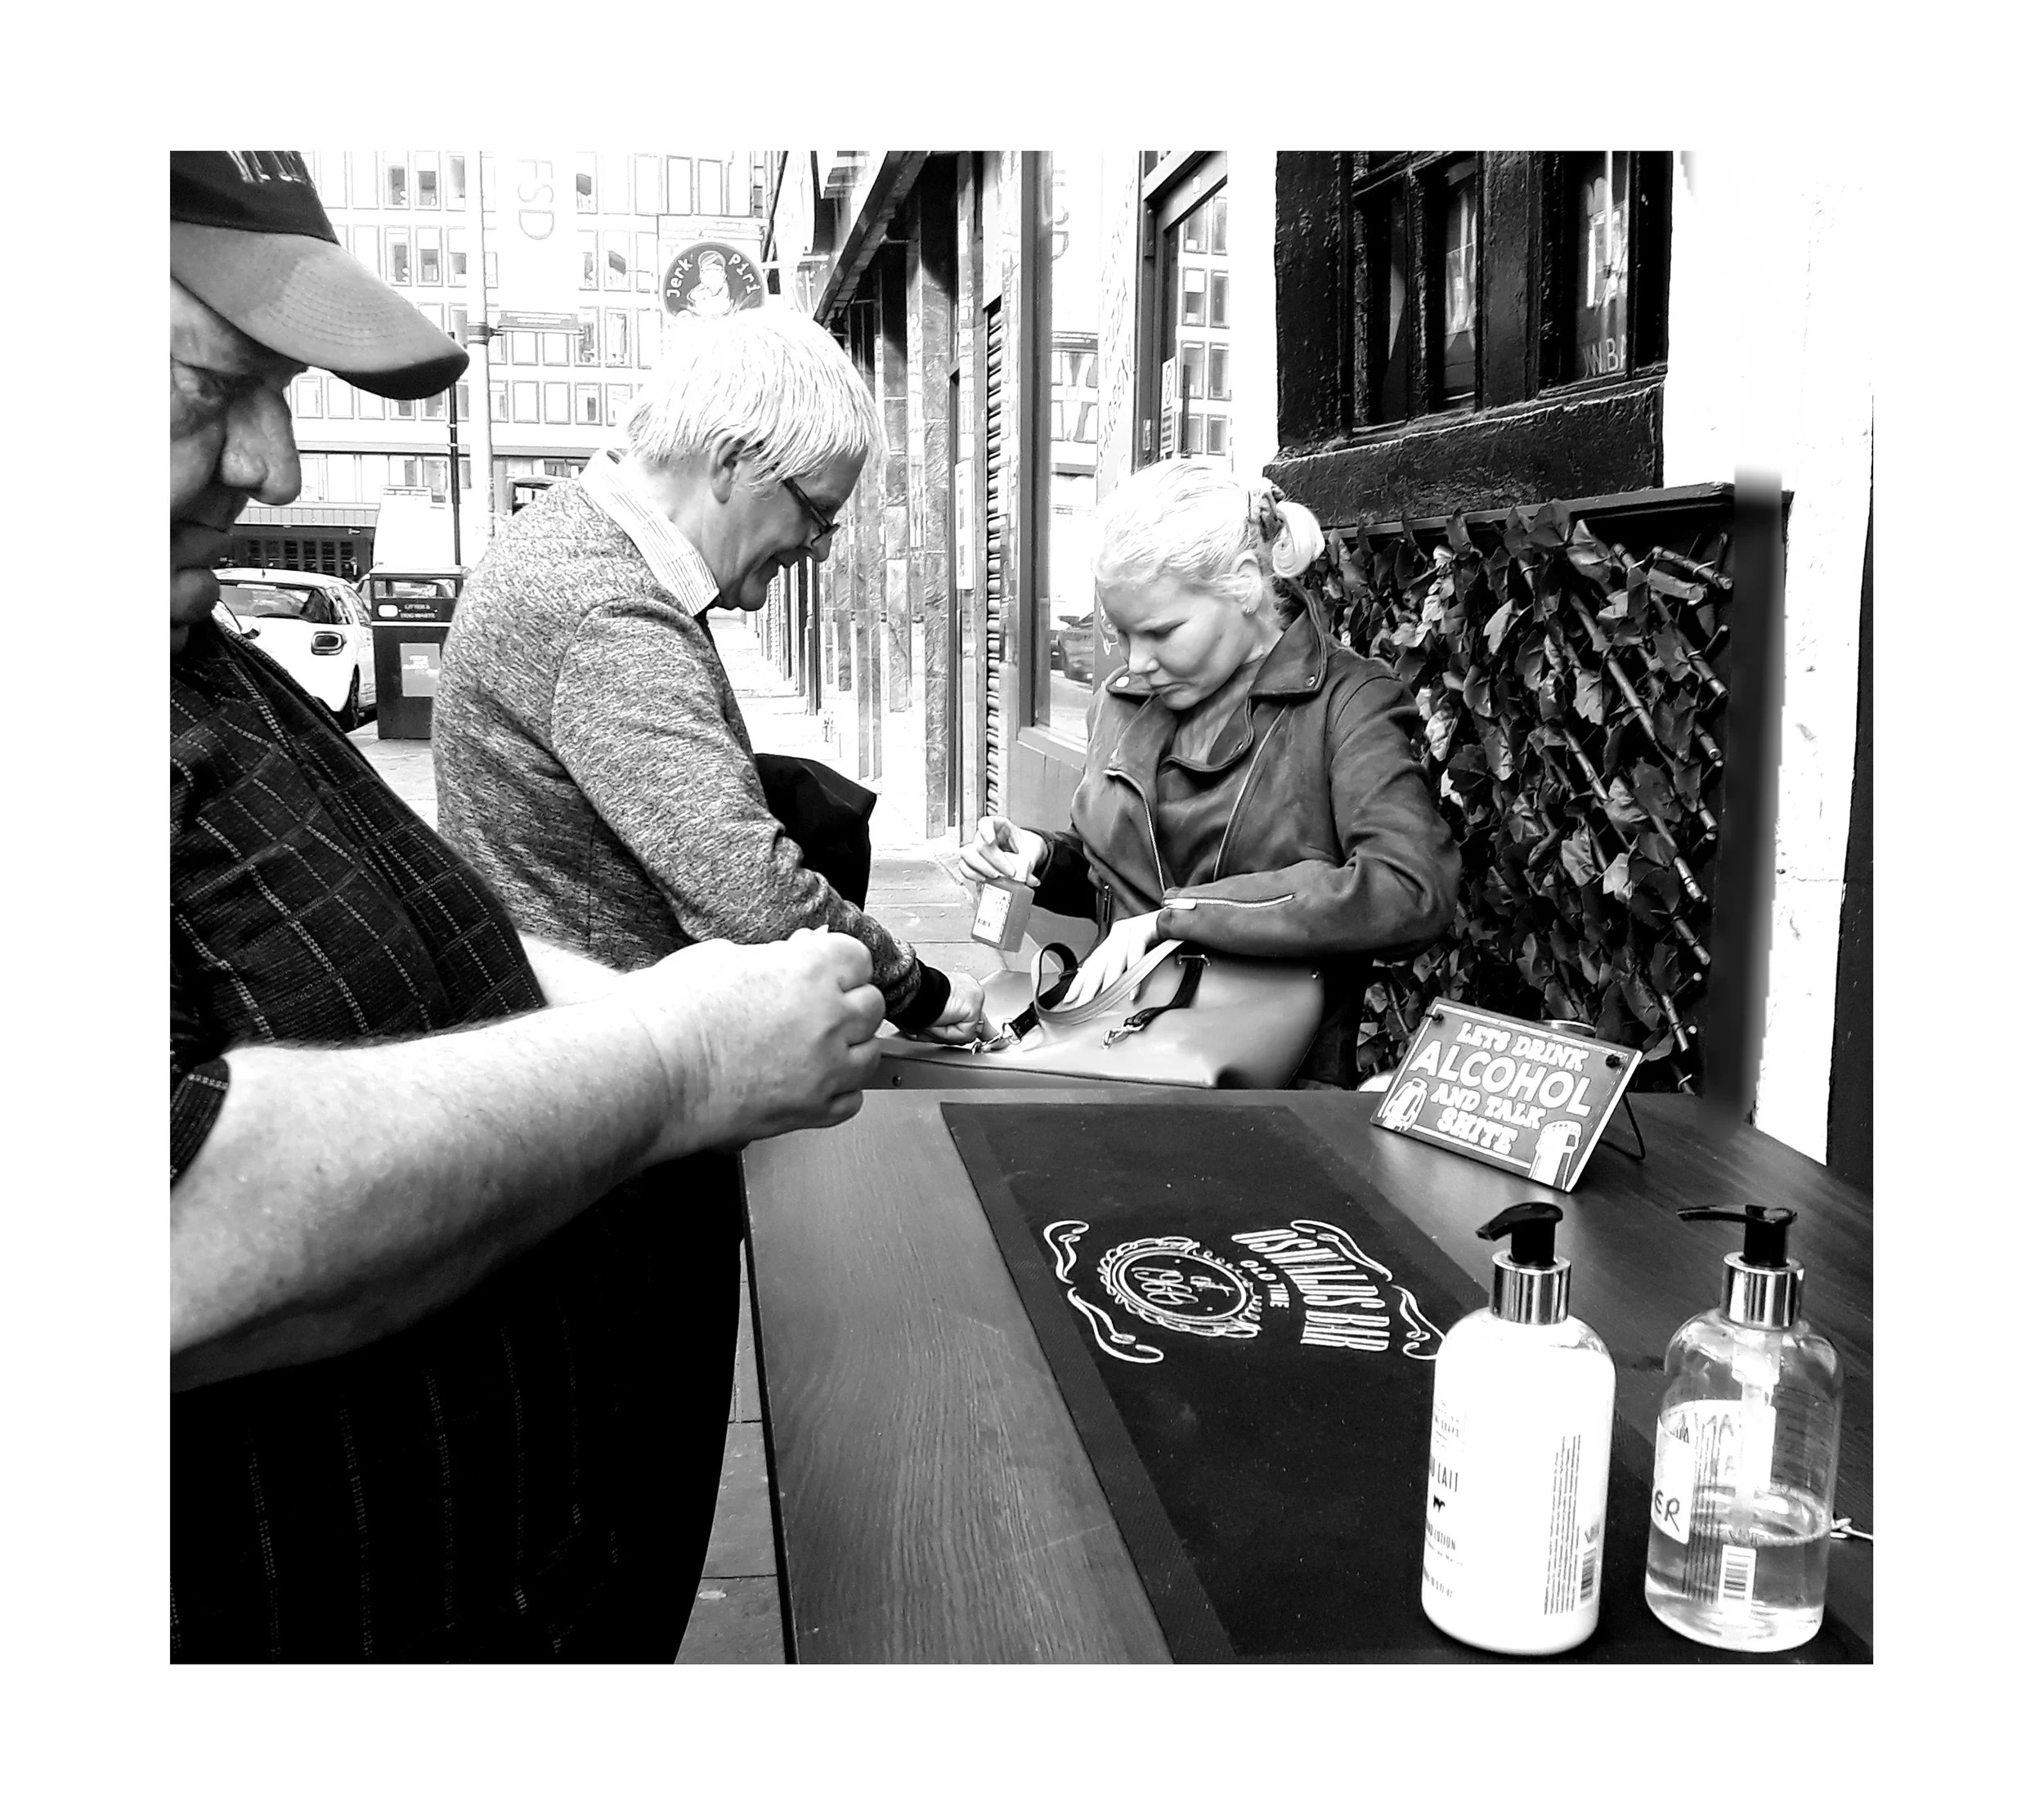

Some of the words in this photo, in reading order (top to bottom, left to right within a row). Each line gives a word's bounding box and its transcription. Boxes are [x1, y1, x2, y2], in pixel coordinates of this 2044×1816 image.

[666, 258, 693, 298] Jerk
[728, 253, 761, 294] Piri
[1456, 1022, 1512, 1052] LETS
[1511, 1035, 1589, 1072] DRINK
[1410, 1040, 1591, 1117] ALCOHOL
[1431, 1083, 1481, 1113] AND
[1483, 1096, 1548, 1130] TALK
[1436, 1107, 1519, 1155] SHITE
[1230, 1228, 1387, 1309] OSWALDS
[1239, 1260, 1277, 1281] OLD
[1267, 1283, 1290, 1308] TIME
[1300, 1309, 1391, 1352] BAR
[1437, 1462, 1459, 1493] LAIT
